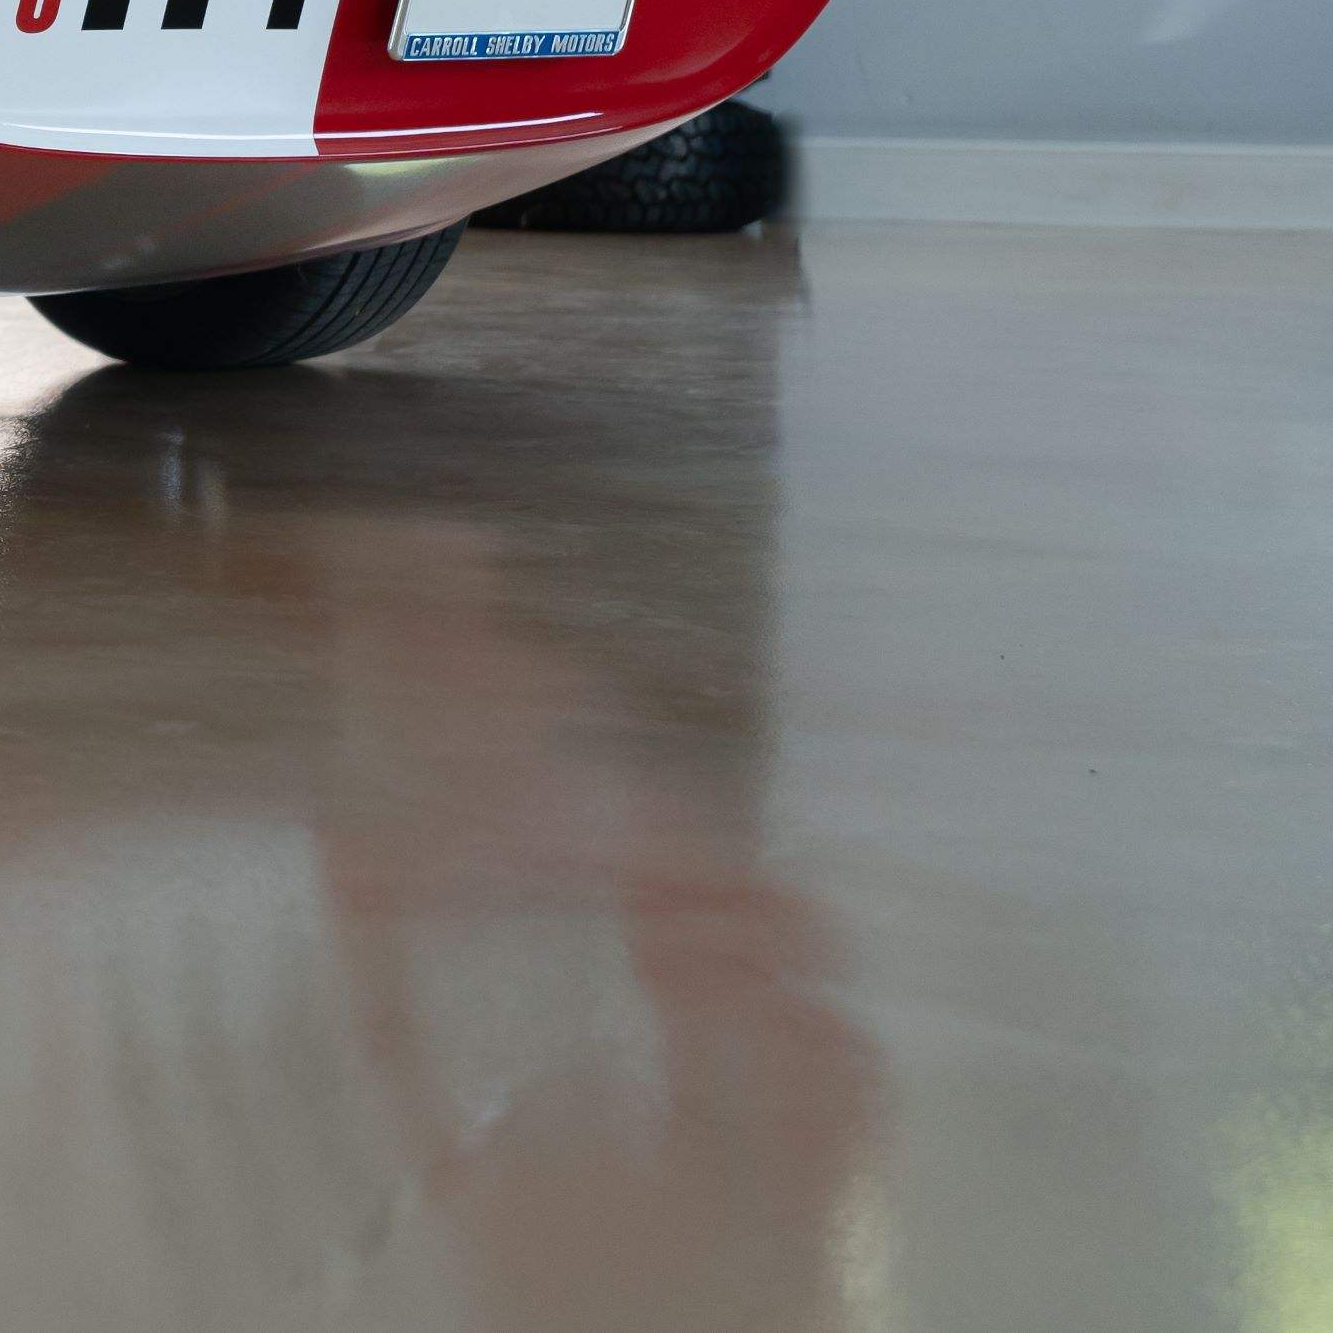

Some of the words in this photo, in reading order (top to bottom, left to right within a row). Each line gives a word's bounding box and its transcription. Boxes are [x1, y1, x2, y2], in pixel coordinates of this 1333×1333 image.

[409, 37, 478, 57] CARROLL
[485, 35, 545, 55] SHELBY
[550, 33, 614, 53] MOTORS
